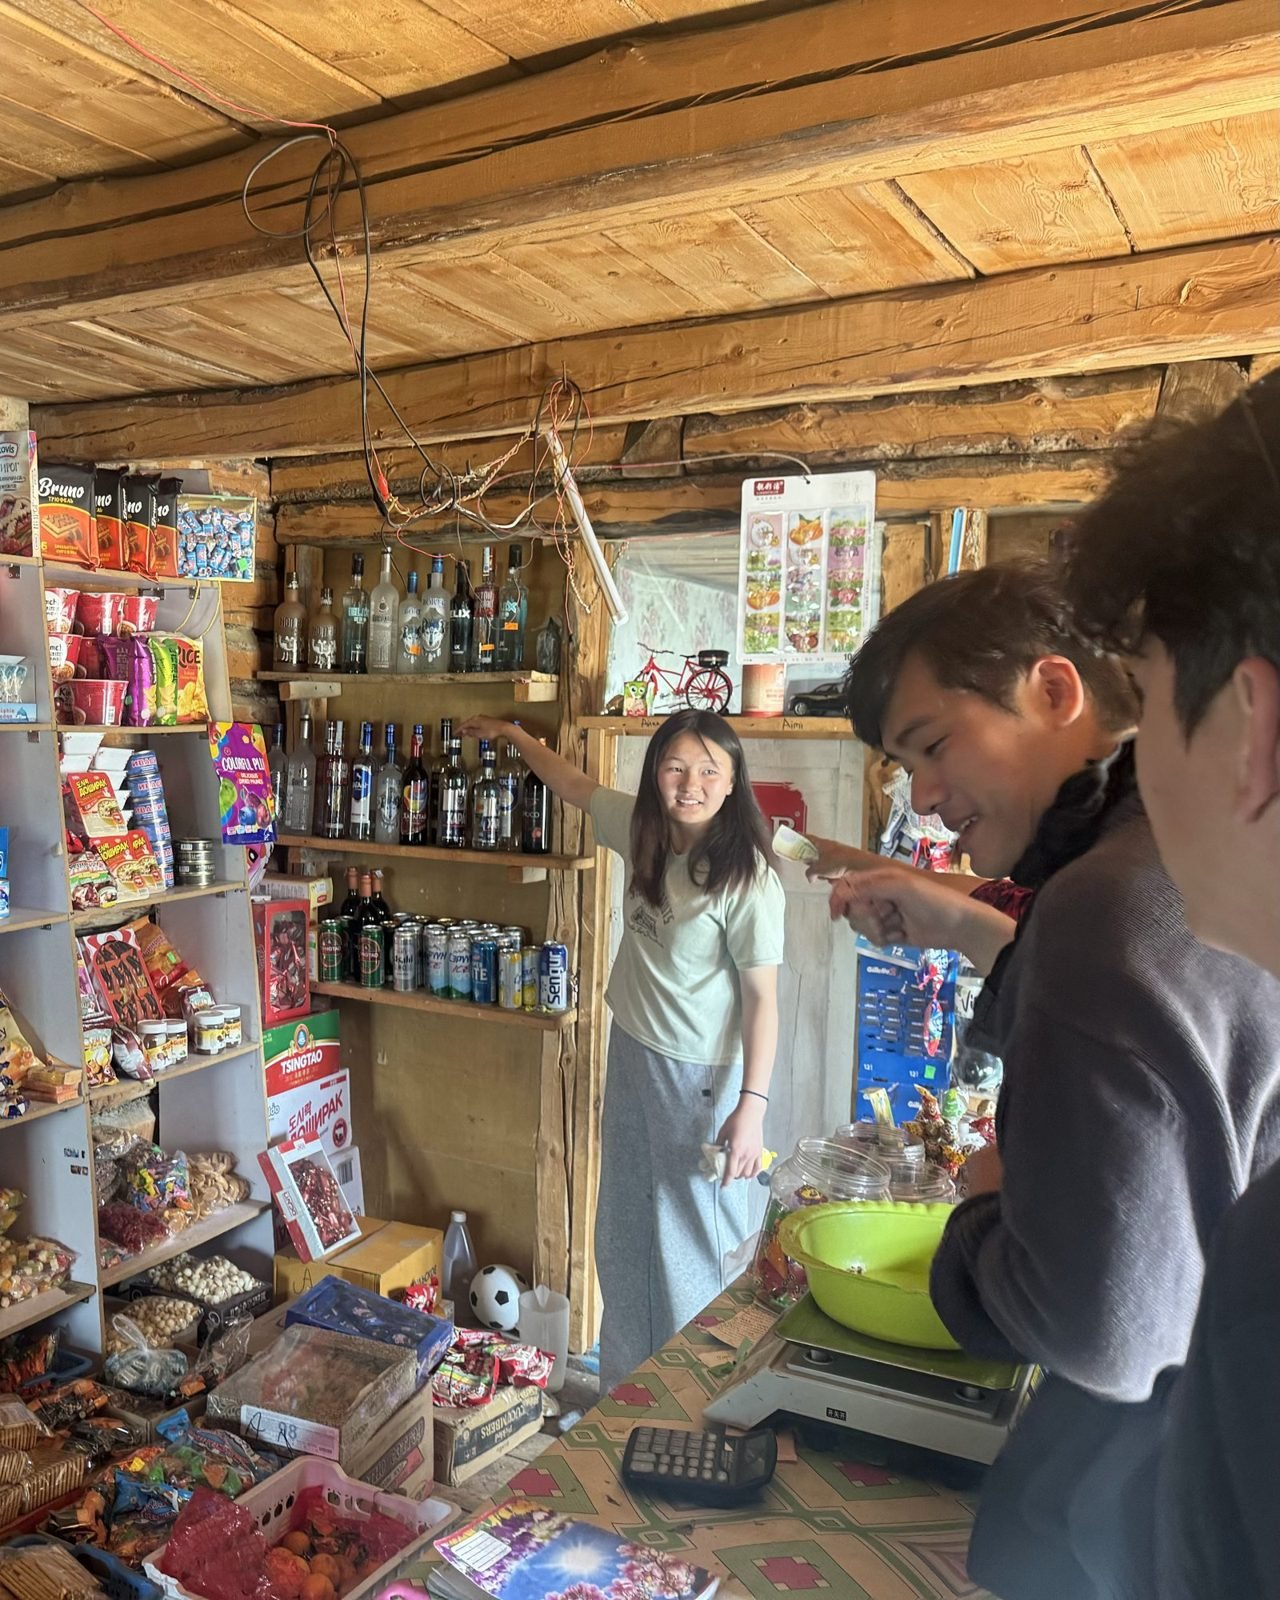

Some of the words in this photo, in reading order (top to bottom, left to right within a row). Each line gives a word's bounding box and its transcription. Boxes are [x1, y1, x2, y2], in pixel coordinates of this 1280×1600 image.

[39, 477, 85, 499] Bruno
[79, 779, 107, 798] ДОШИРАК
[281, 1049, 323, 1074] TSINGTAO
[481, 1405, 526, 1440] CUCUMBERS
